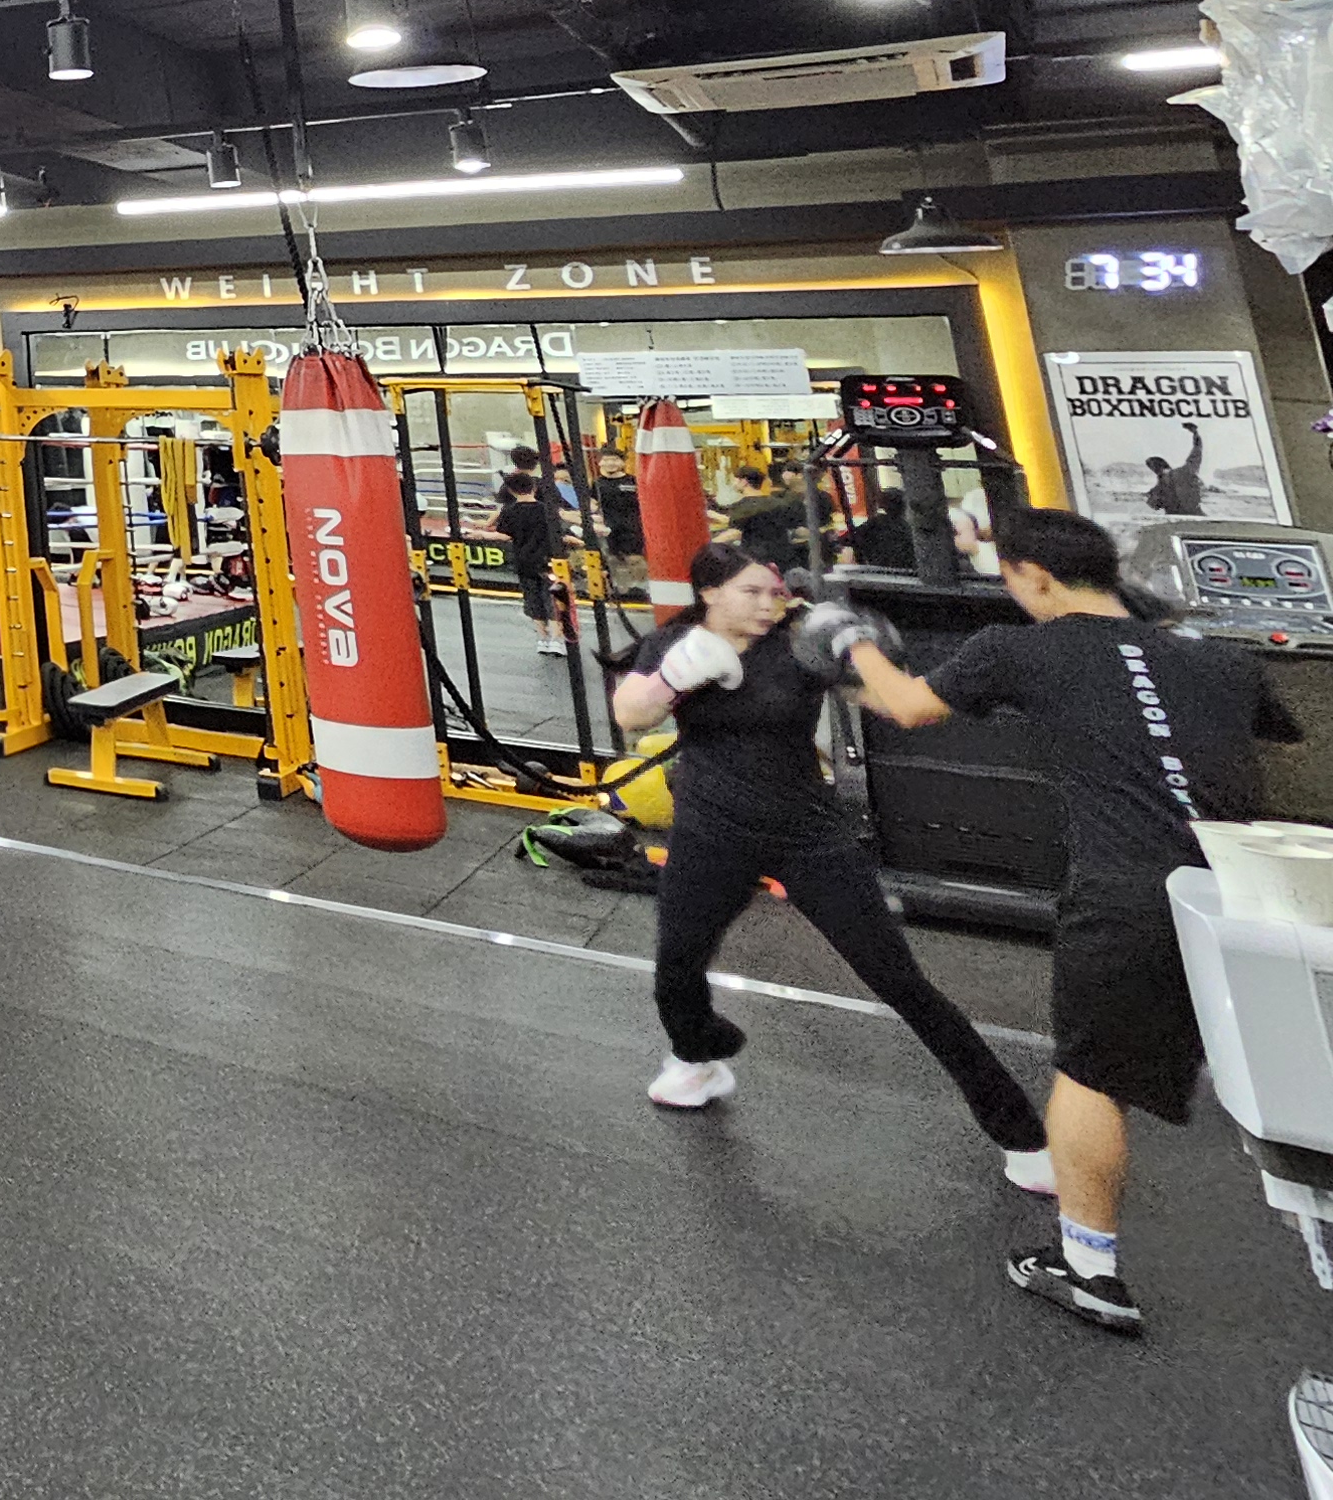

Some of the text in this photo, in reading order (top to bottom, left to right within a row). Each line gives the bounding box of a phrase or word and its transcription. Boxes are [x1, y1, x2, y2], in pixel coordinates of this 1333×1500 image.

[504, 257, 716, 290] ZONE
[1075, 375, 1233, 396] DRAGON
[1066, 397, 1251, 418] BOXINGCLUB
[428, 542, 506, 567] CUB
[312, 507, 360, 668] NOVA
